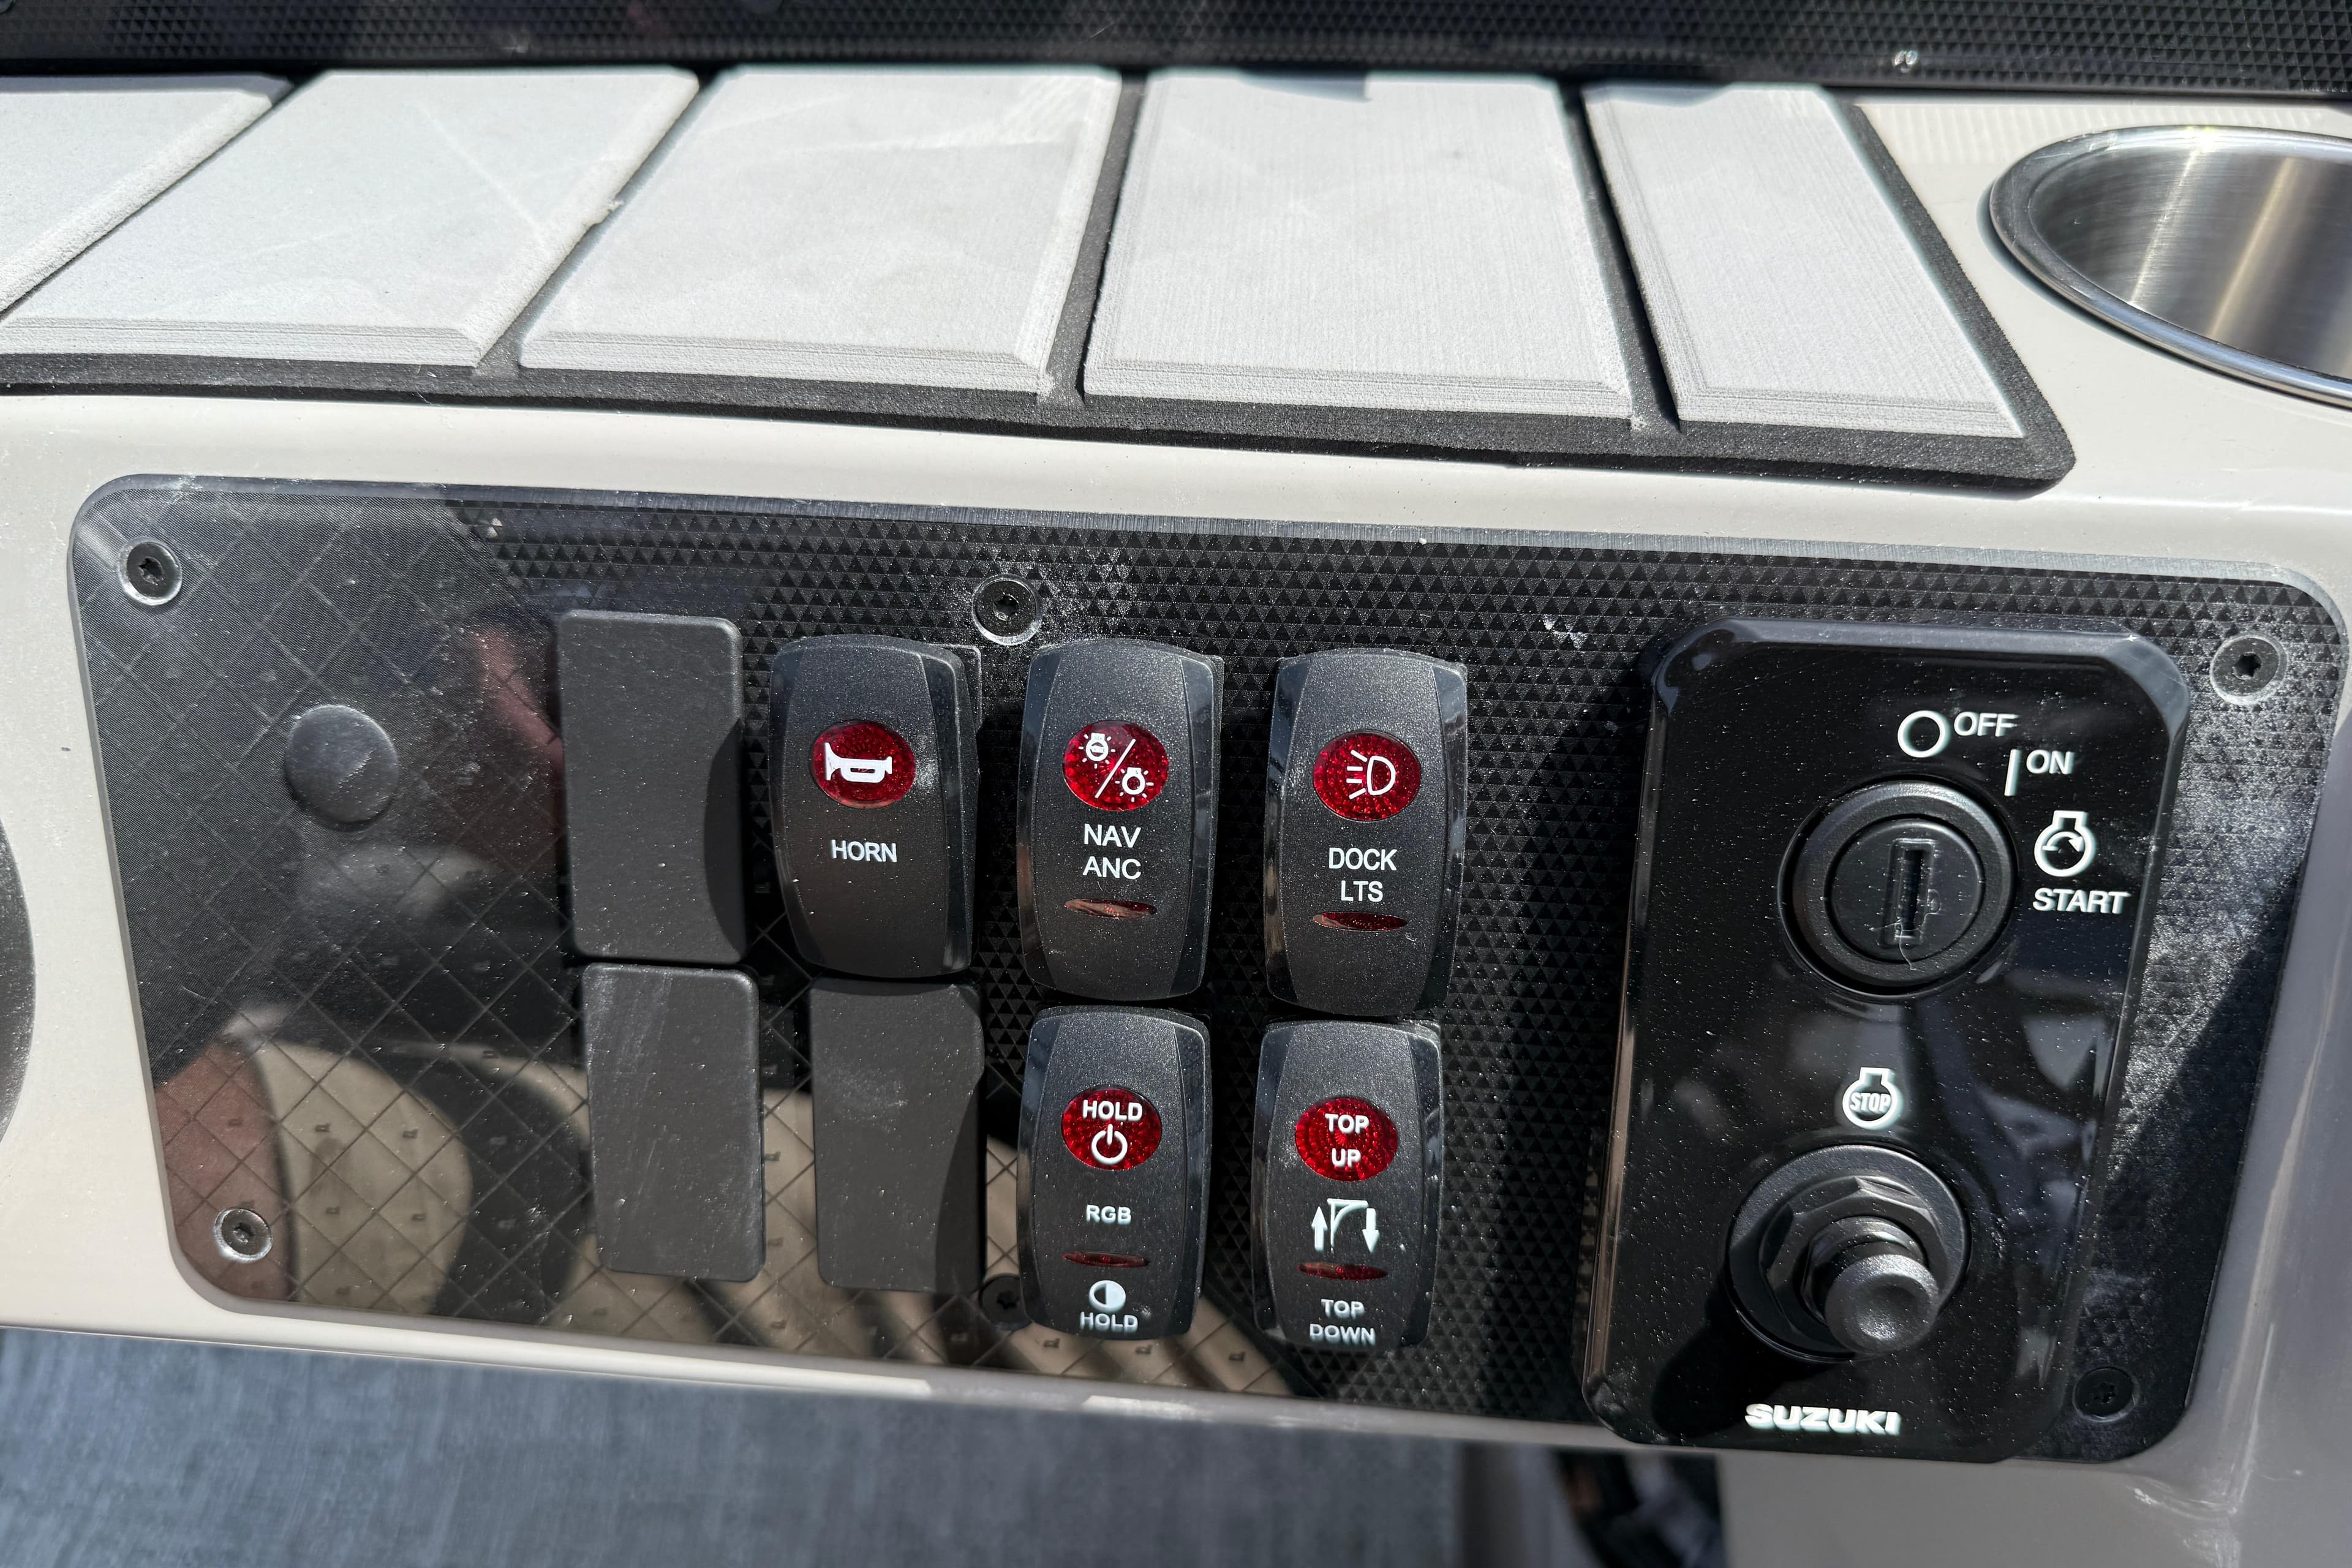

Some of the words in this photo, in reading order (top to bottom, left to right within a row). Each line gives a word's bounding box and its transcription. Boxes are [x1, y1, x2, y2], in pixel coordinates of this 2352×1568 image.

[1954, 712, 2018, 736] OFF
[2026, 749, 2075, 774] ON
[1084, 823, 1141, 848] NAV
[832, 839, 897, 863] HORN
[1328, 847, 1397, 871] DOCK
[1082, 856, 1141, 880] ANC
[1341, 880, 1383, 902] LTS
[2033, 888, 2130, 914] START
[1082, 1100, 1143, 1121] HOLD
[1850, 1092, 1891, 1113] STOP
[1325, 1113, 1370, 1134] TOP
[1332, 1148, 1361, 1167] UP
[1086, 1204, 1131, 1224] RGB
[1321, 1298, 1365, 1319] TOP
[1079, 1311, 1138, 1333] HOLD
[1310, 1324, 1375, 1344] DOWN
[1745, 1403, 1902, 1436] SUZUKI
